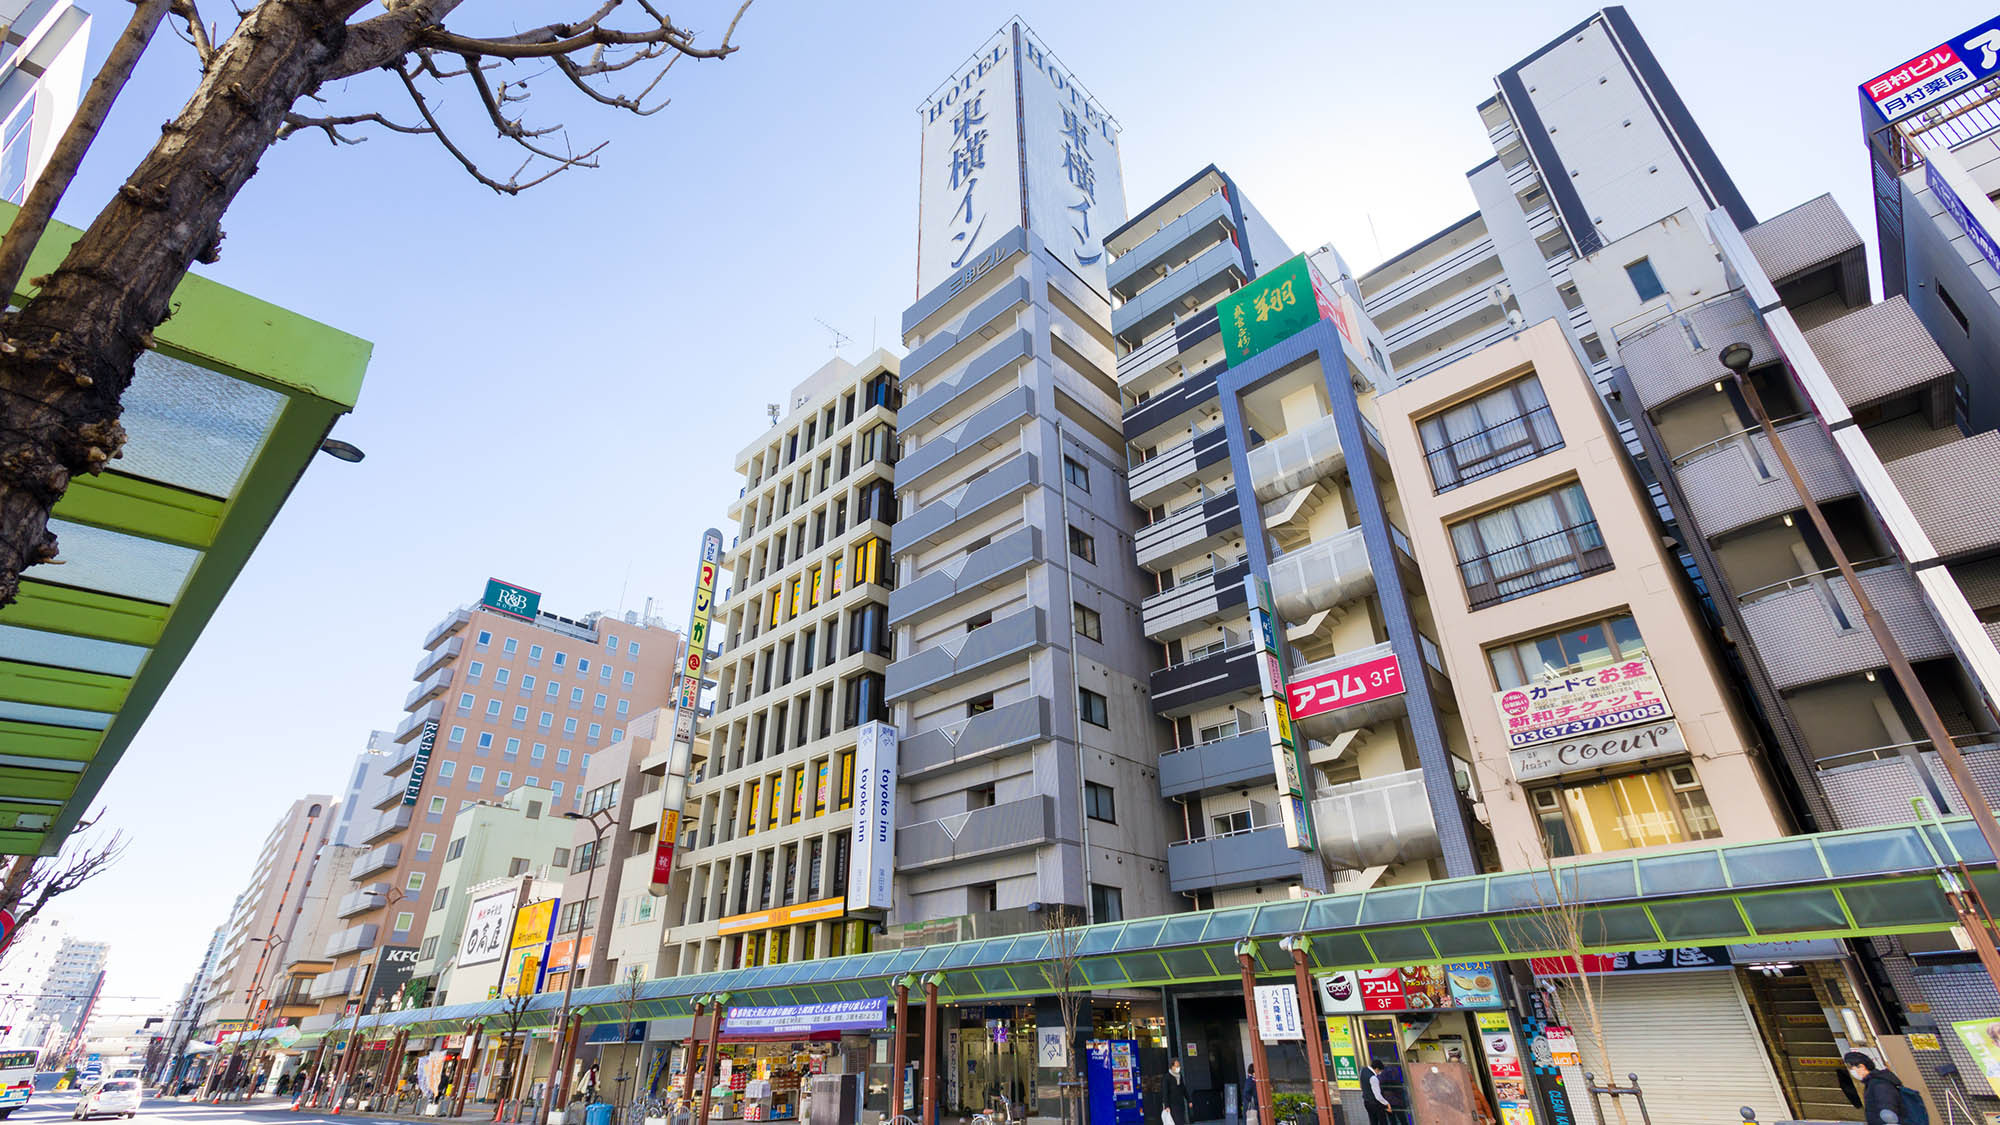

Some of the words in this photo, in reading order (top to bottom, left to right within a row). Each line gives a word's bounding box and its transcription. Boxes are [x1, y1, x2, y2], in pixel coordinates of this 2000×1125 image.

[928, 44, 1008, 126] HOTEL
[1025, 38, 1115, 146] HOTEL
[1869, 52, 1952, 98] 月村ビル
[1884, 67, 1969, 115] 月村薬局
[947, 88, 990, 269] 東横イン
[1058, 101, 1102, 267] 東横イン
[498, 589, 527, 610] R&B
[1292, 674, 1367, 713] アコム
[1370, 666, 1396, 687] 3F
[1530, 661, 1650, 701] カードでお金
[1509, 690, 1654, 728] 新和チケット
[1513, 704, 1664, 745] 03(3737)0008
[420, 721, 439, 750] R&B
[407, 750, 431, 805] HOTEL
[859, 768, 869, 815] toyoko
[880, 769, 891, 816] toyoko
[858, 821, 866, 842] inn
[880, 821, 889, 842] inn
[1363, 980, 1399, 994] アコム
[1377, 998, 1392, 1008] 3F
[1548, 1090, 1566, 1114] CLEAN
